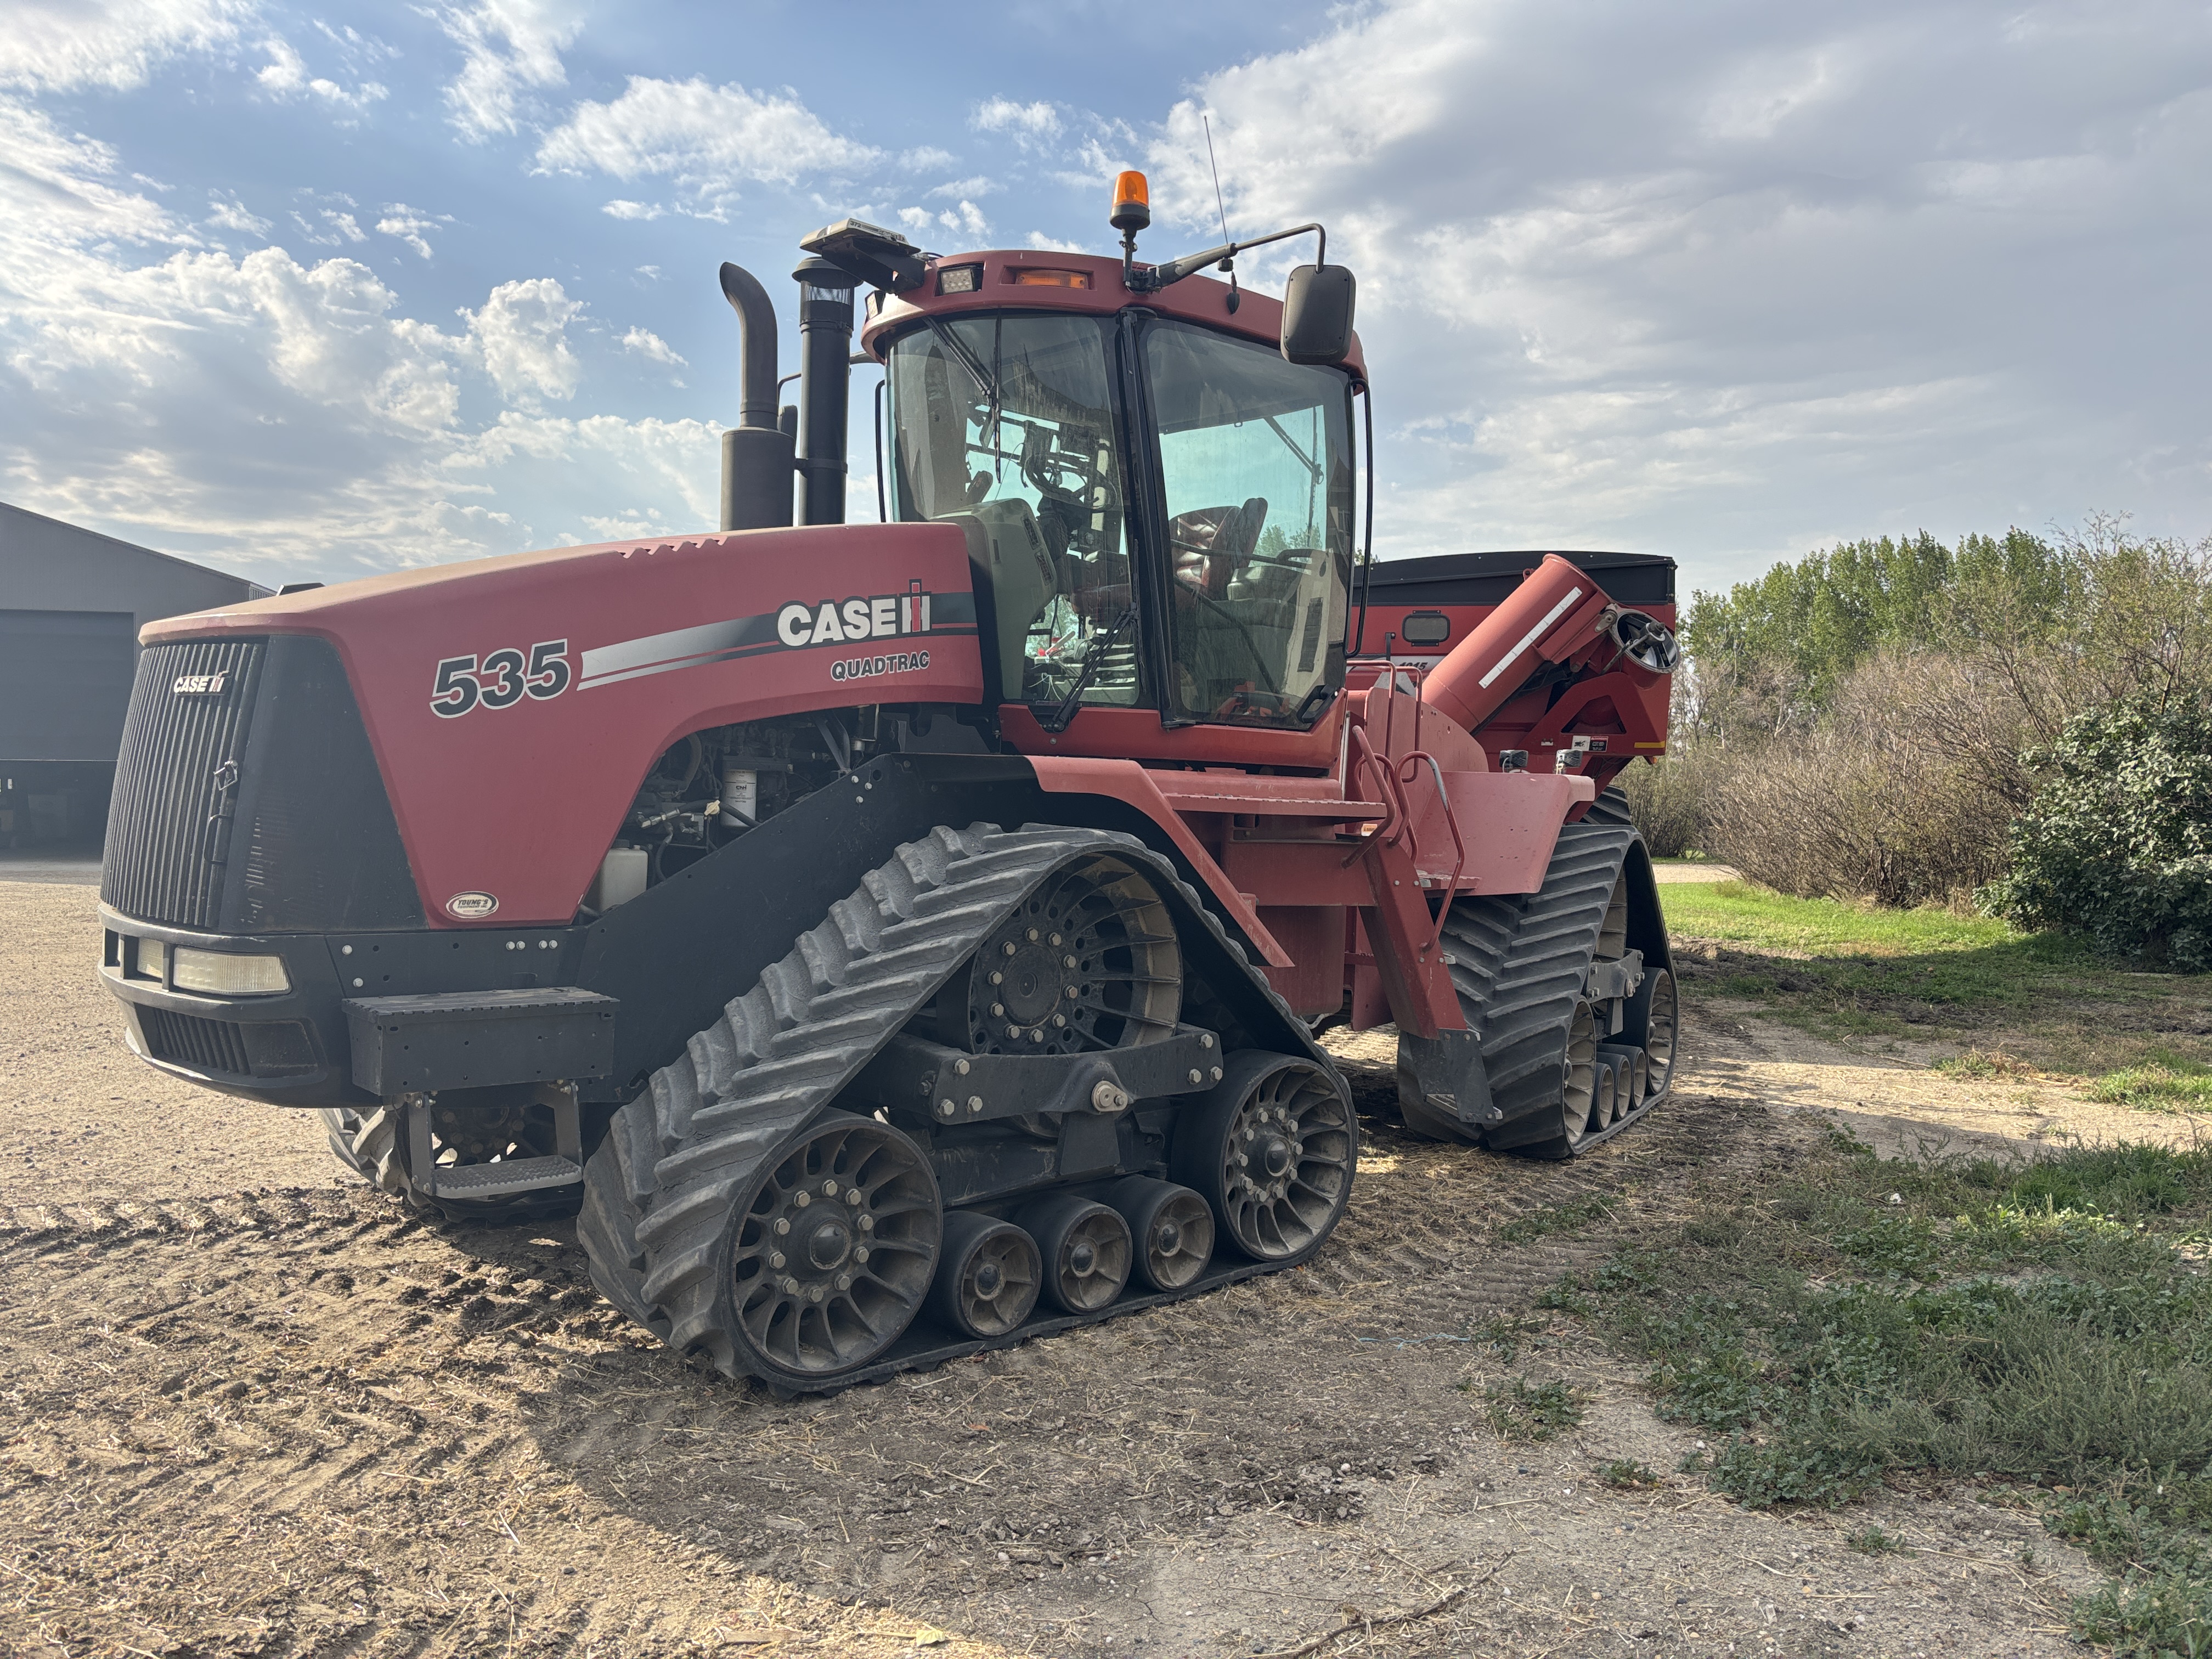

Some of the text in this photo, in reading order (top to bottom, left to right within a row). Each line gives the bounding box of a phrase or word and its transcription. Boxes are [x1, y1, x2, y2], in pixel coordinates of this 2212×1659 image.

[777, 598, 896, 646] CASE
[173, 676, 210, 693] CASE
[430, 638, 571, 719] 535
[831, 650, 930, 682] QUADTRAC
